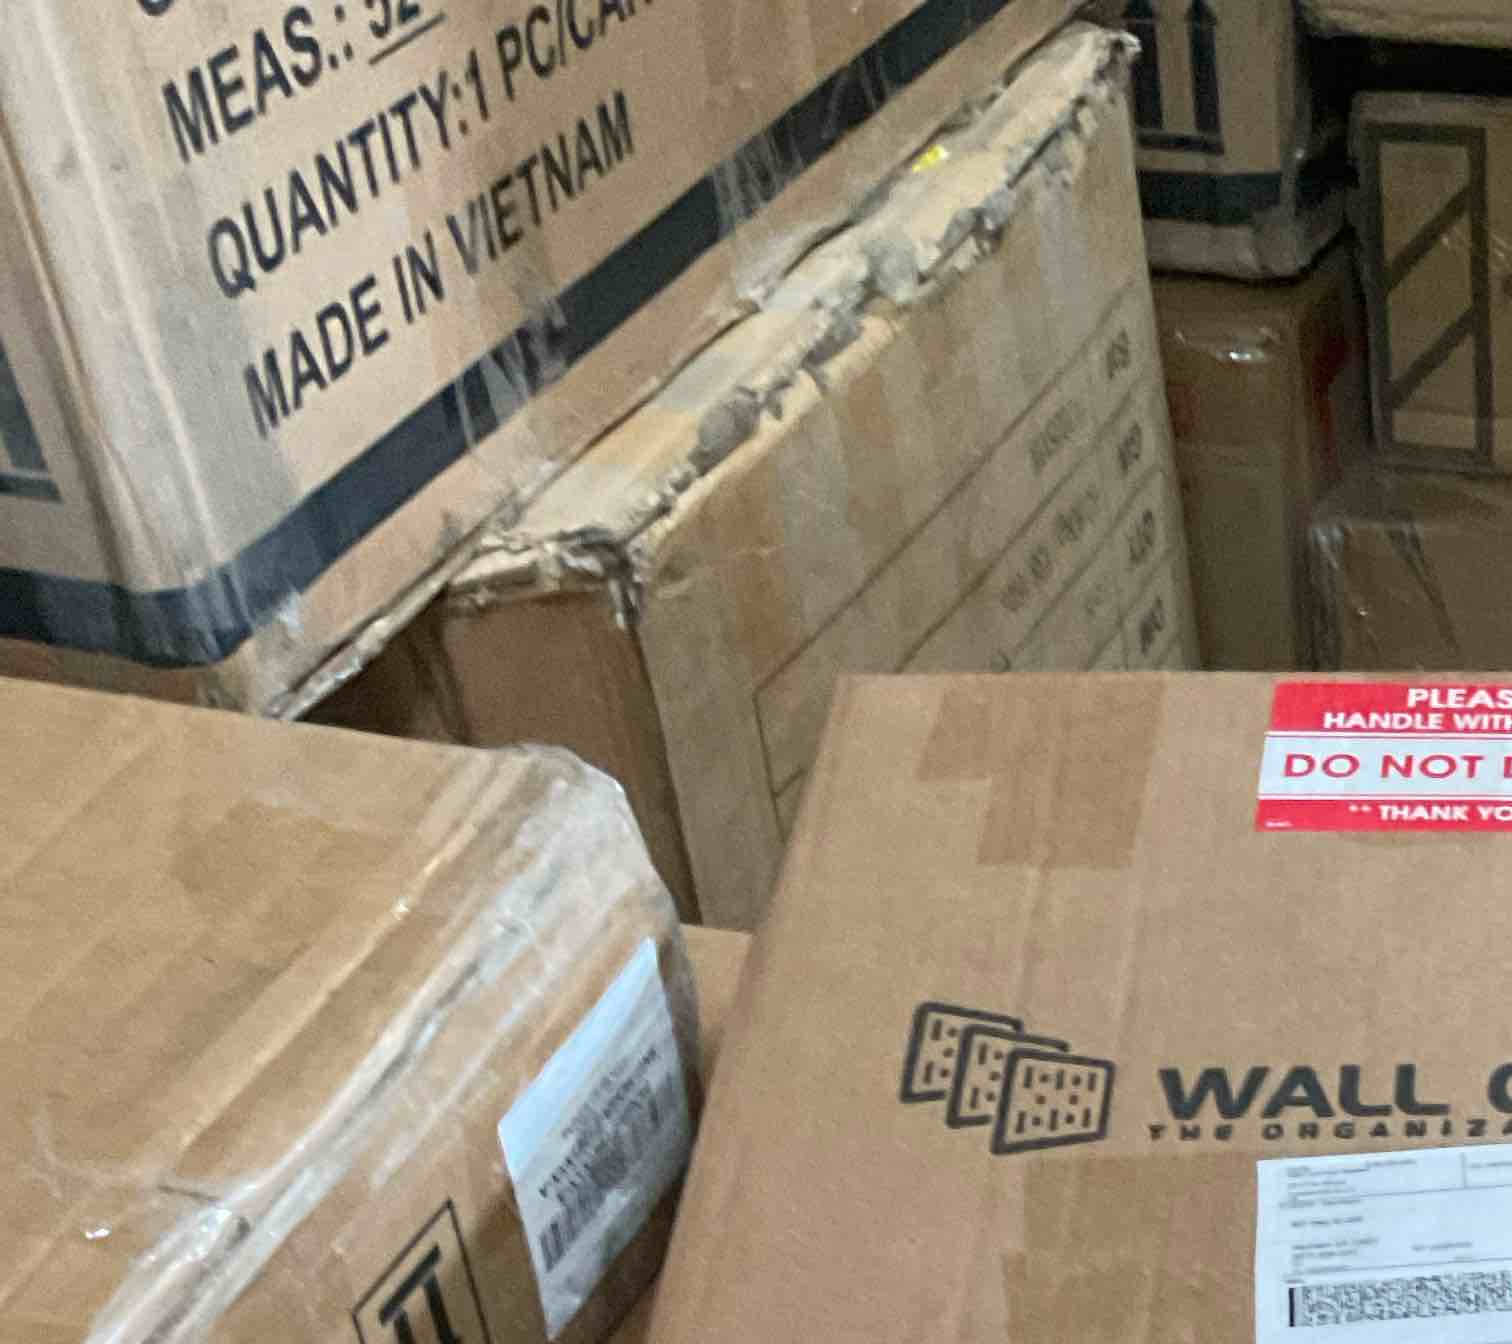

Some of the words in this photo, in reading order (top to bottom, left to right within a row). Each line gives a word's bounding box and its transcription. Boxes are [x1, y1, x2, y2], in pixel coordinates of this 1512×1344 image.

[242, 276, 389, 438] MADE
[394, 231, 446, 326] IN
[445, 89, 636, 278] VIETNAM
[1323, 711, 1443, 730] HANDLE
[1283, 752, 1359, 778] DO
[1380, 753, 1484, 780] NOT
[1379, 804, 1473, 822] THANK
[1158, 1063, 1451, 1121] WALL
[1148, 1121, 1234, 1142] THE
